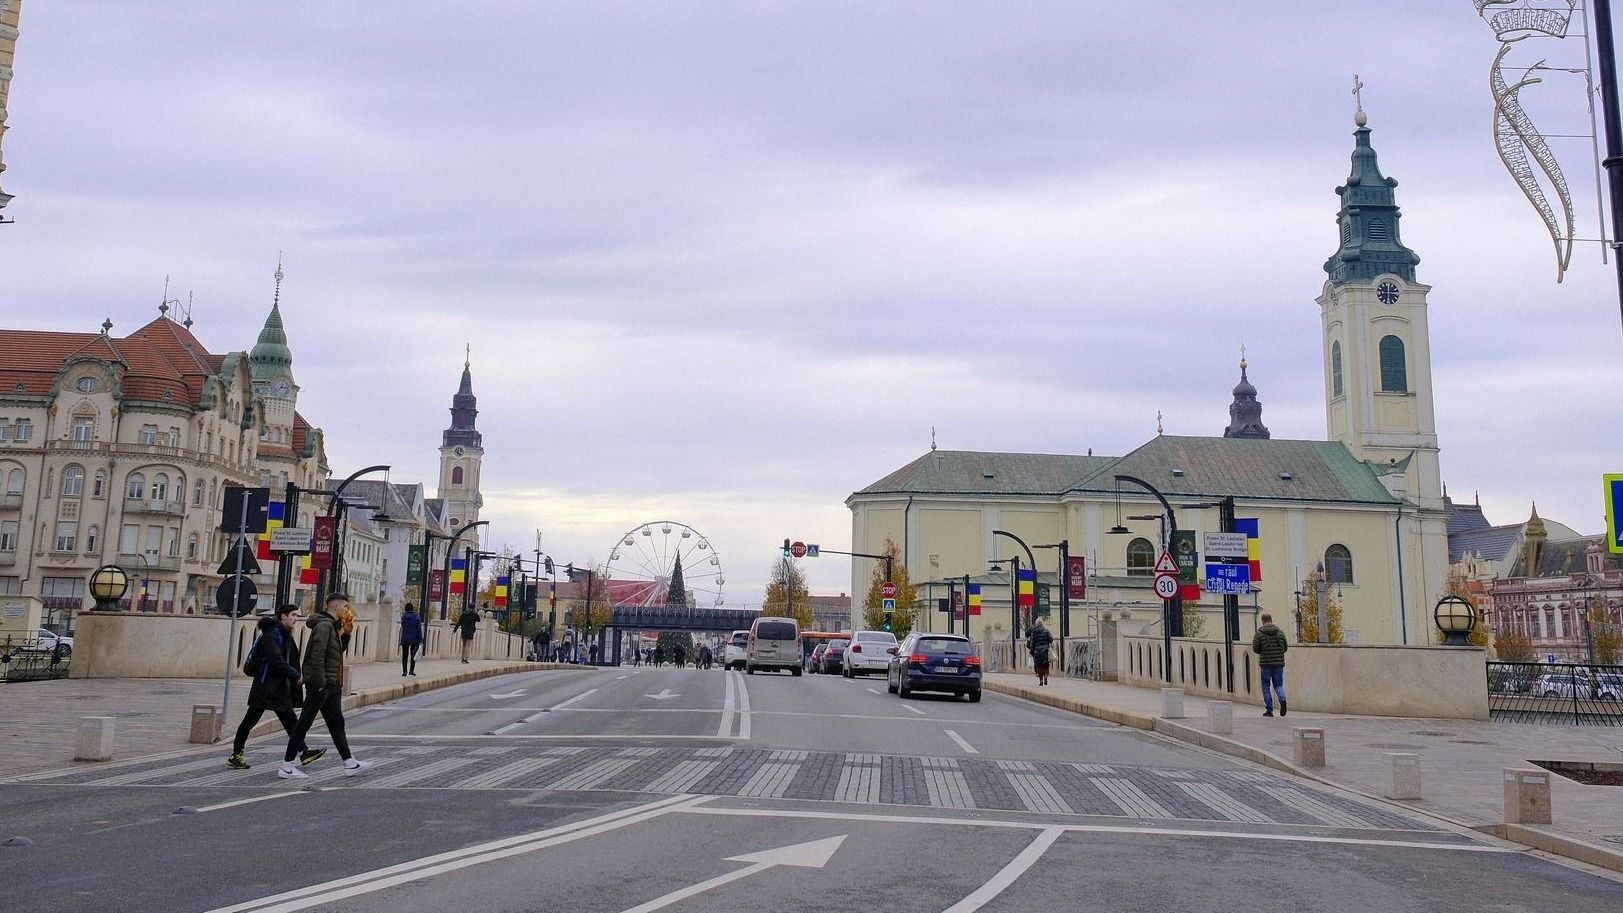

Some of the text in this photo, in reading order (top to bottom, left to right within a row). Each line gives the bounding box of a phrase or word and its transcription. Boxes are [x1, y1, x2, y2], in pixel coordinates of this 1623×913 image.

[792, 545, 806, 554] STOP
[1225, 565, 1237, 577] râul
[881, 586, 896, 595] STOP
[1160, 580, 1173, 592] 30
[1226, 579, 1249, 593] Repede
